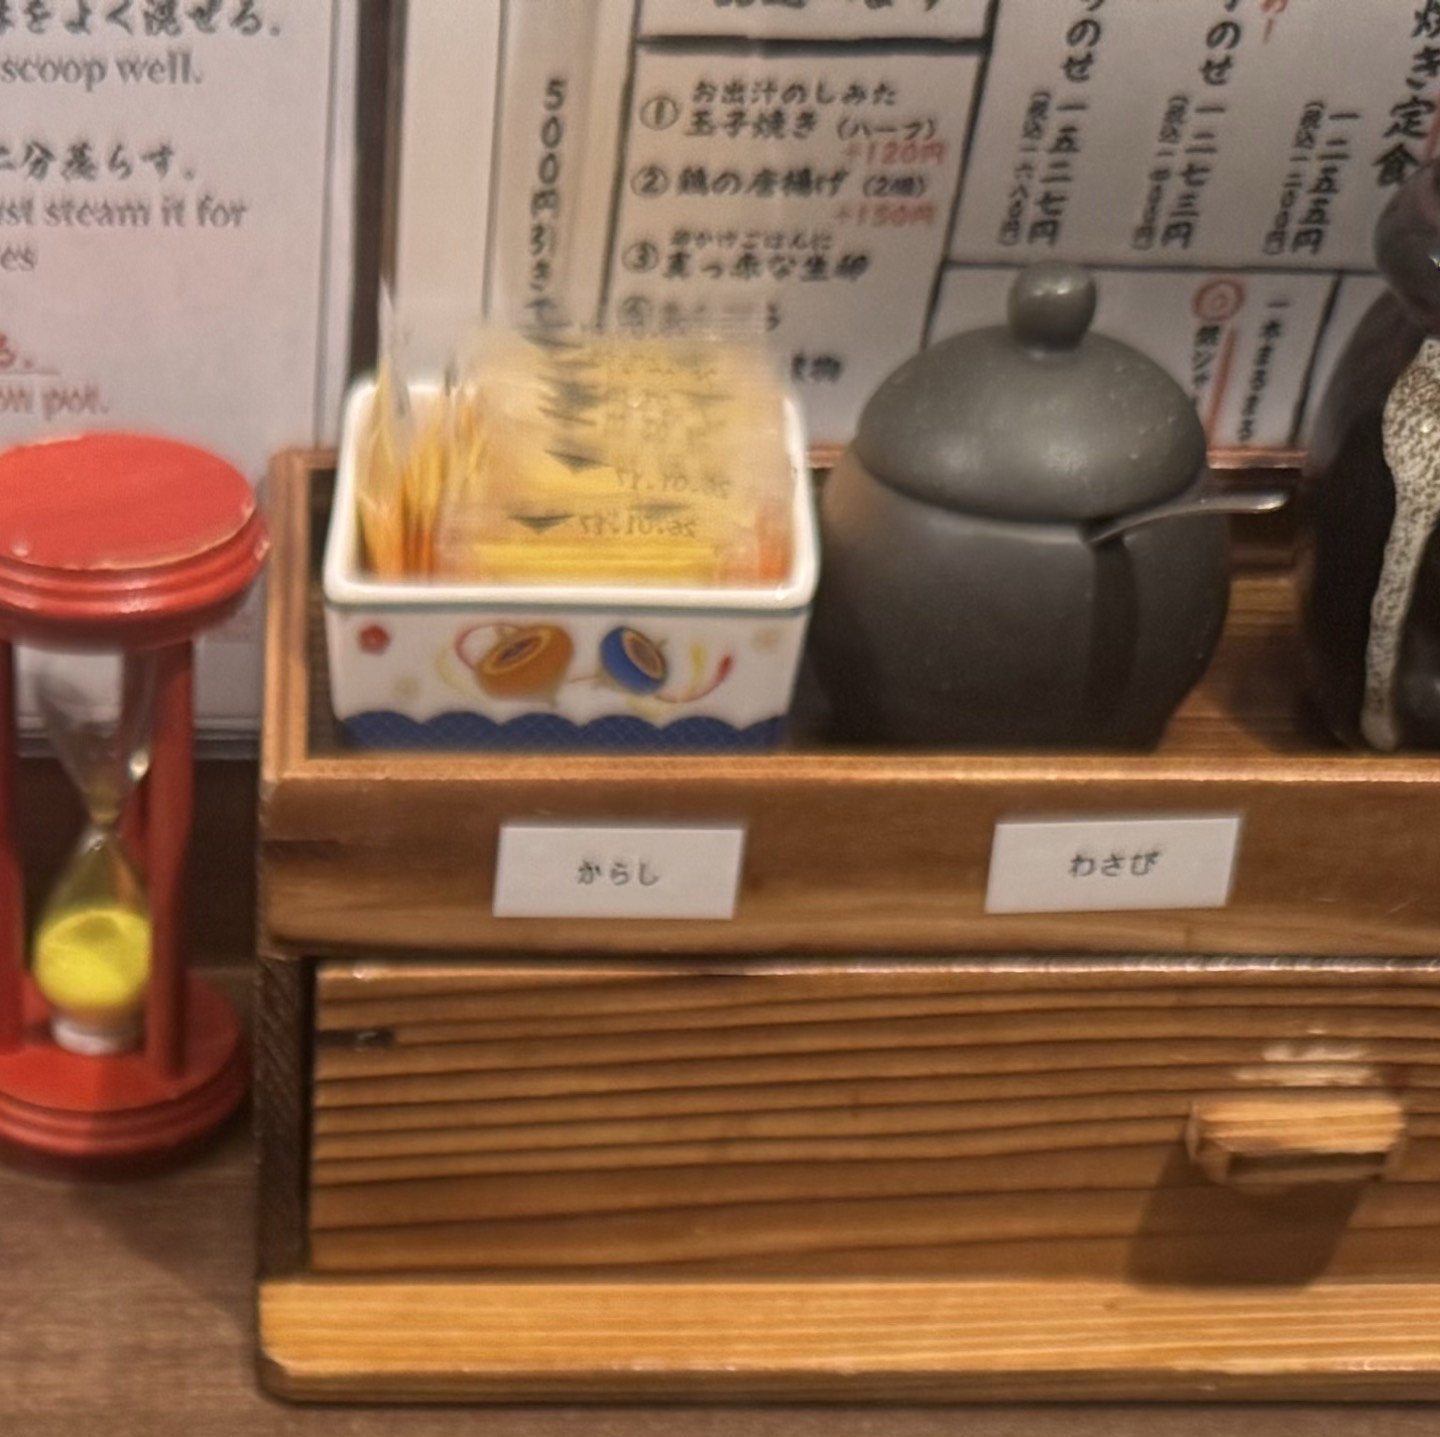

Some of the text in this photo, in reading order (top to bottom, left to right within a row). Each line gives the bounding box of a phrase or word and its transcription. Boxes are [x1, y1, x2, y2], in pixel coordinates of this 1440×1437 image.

[1062, 0, 1103, 83] のせ
[1200, 0, 1242, 86] のせ
[0, 57, 108, 92] scoop
[116, 50, 203, 84] well.
[684, 109, 818, 139] 玉子焼き
[45, 200, 152, 227] steam
[161, 198, 187, 227] it
[196, 196, 248, 227] for
[576, 859, 662, 887] からし
[1067, 850, 1161, 877] わさび
